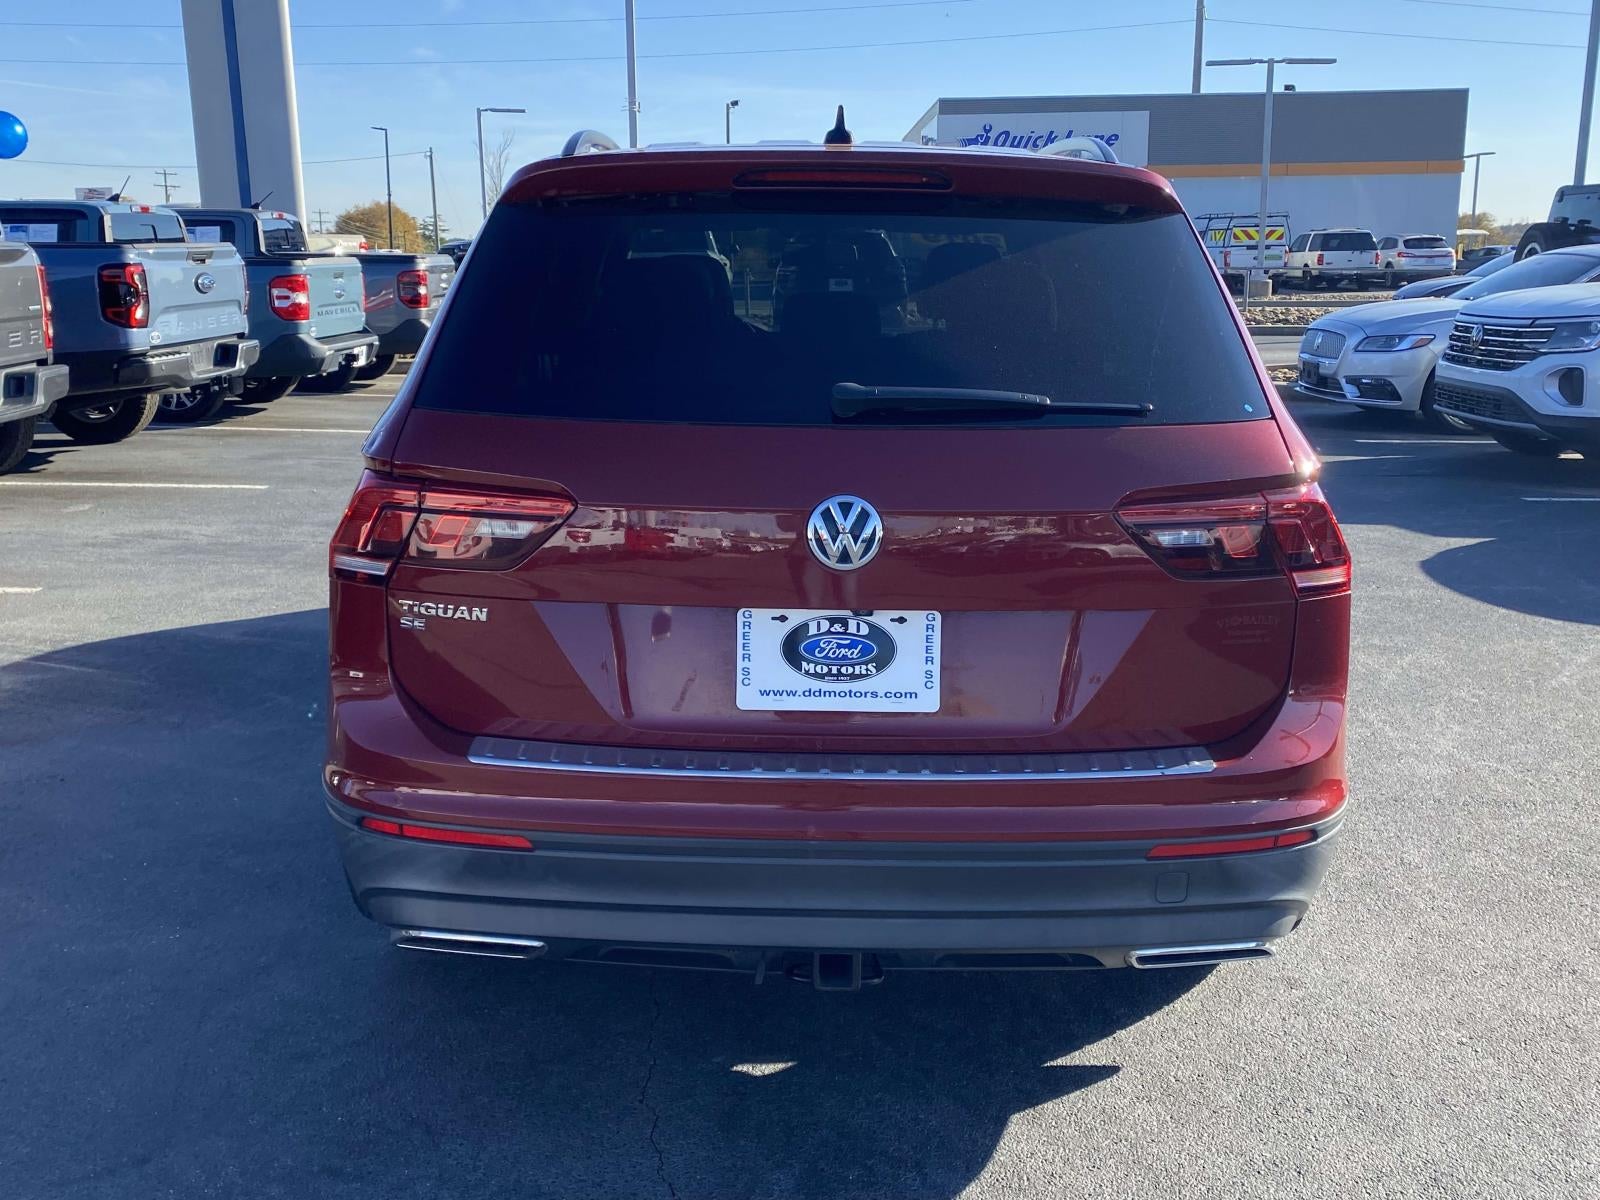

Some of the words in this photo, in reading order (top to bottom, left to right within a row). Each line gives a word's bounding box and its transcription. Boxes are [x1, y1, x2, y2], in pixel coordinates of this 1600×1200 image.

[992, 130, 1058, 149] Quick
[398, 599, 488, 621] TIGUAN
[400, 616, 426, 630] SE
[807, 618, 870, 636] D&D
[741, 609, 752, 662] GREER
[925, 612, 936, 665] GREER
[814, 638, 862, 660] Ford
[801, 661, 877, 675] MOTORS
[758, 688, 918, 700] www.ddmotors.com
